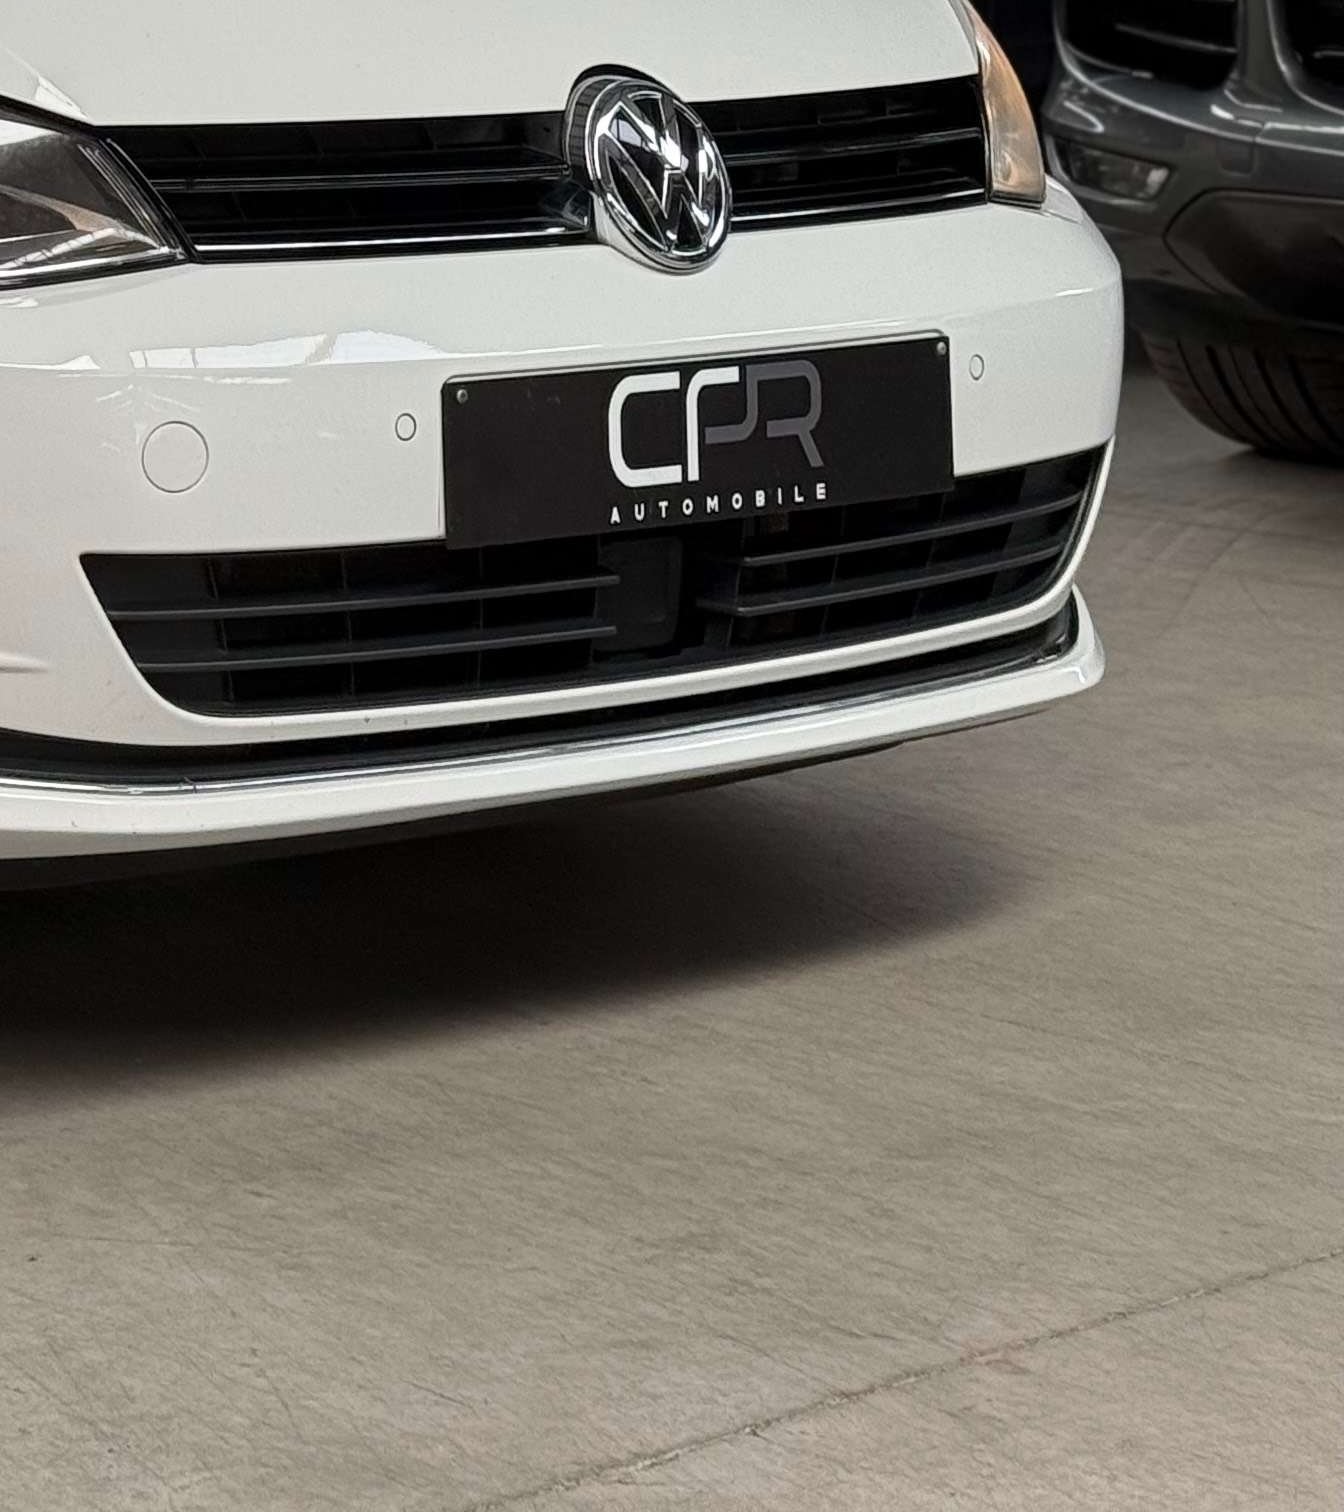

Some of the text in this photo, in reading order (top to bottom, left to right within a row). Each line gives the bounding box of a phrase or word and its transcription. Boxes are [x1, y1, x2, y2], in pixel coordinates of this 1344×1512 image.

[588, 85, 724, 260] VW
[608, 358, 825, 488] CPR
[609, 482, 828, 525] AUTOMOBILE
